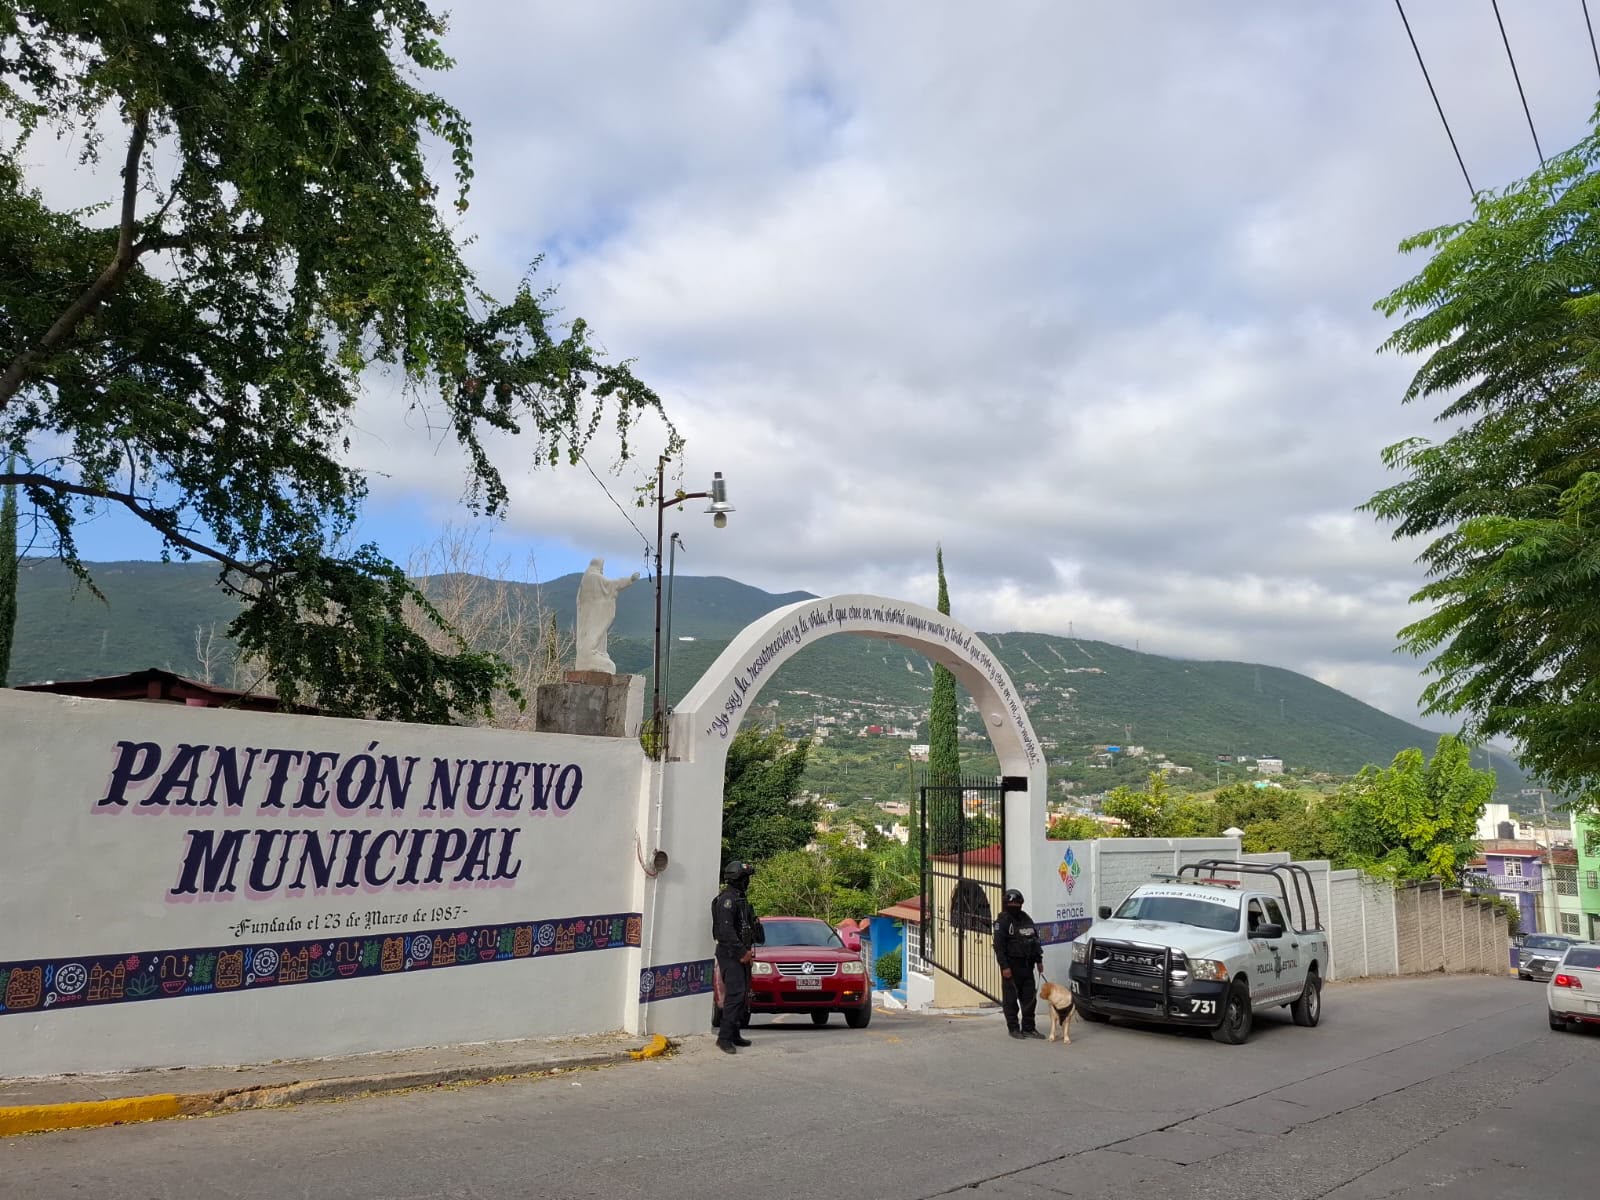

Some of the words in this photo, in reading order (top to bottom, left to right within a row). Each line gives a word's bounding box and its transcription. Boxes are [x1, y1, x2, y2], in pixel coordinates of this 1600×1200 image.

[725, 690, 743, 713] soy
[734, 676, 751, 696] la
[792, 624, 801, 643] y
[798, 615, 809, 633] la
[827, 603, 835, 621] el
[835, 607, 847, 628] que
[863, 607, 872, 620] en
[906, 614, 927, 635] aunque
[944, 627, 951, 642] y
[950, 627, 963, 646] todo
[963, 636, 972, 651] el
[95, 741, 421, 812] PANTEÓN
[421, 757, 583, 813] NUEVO
[168, 828, 522, 898] MUNICIPAL
[306, 915, 319, 930] el
[324, 913, 341, 929] 23
[345, 911, 360, 928] de
[364, 910, 408, 930] Marzo
[412, 908, 427, 923] de
[1113, 953, 1152, 965] RAM
[1191, 998, 1216, 1014] 731
